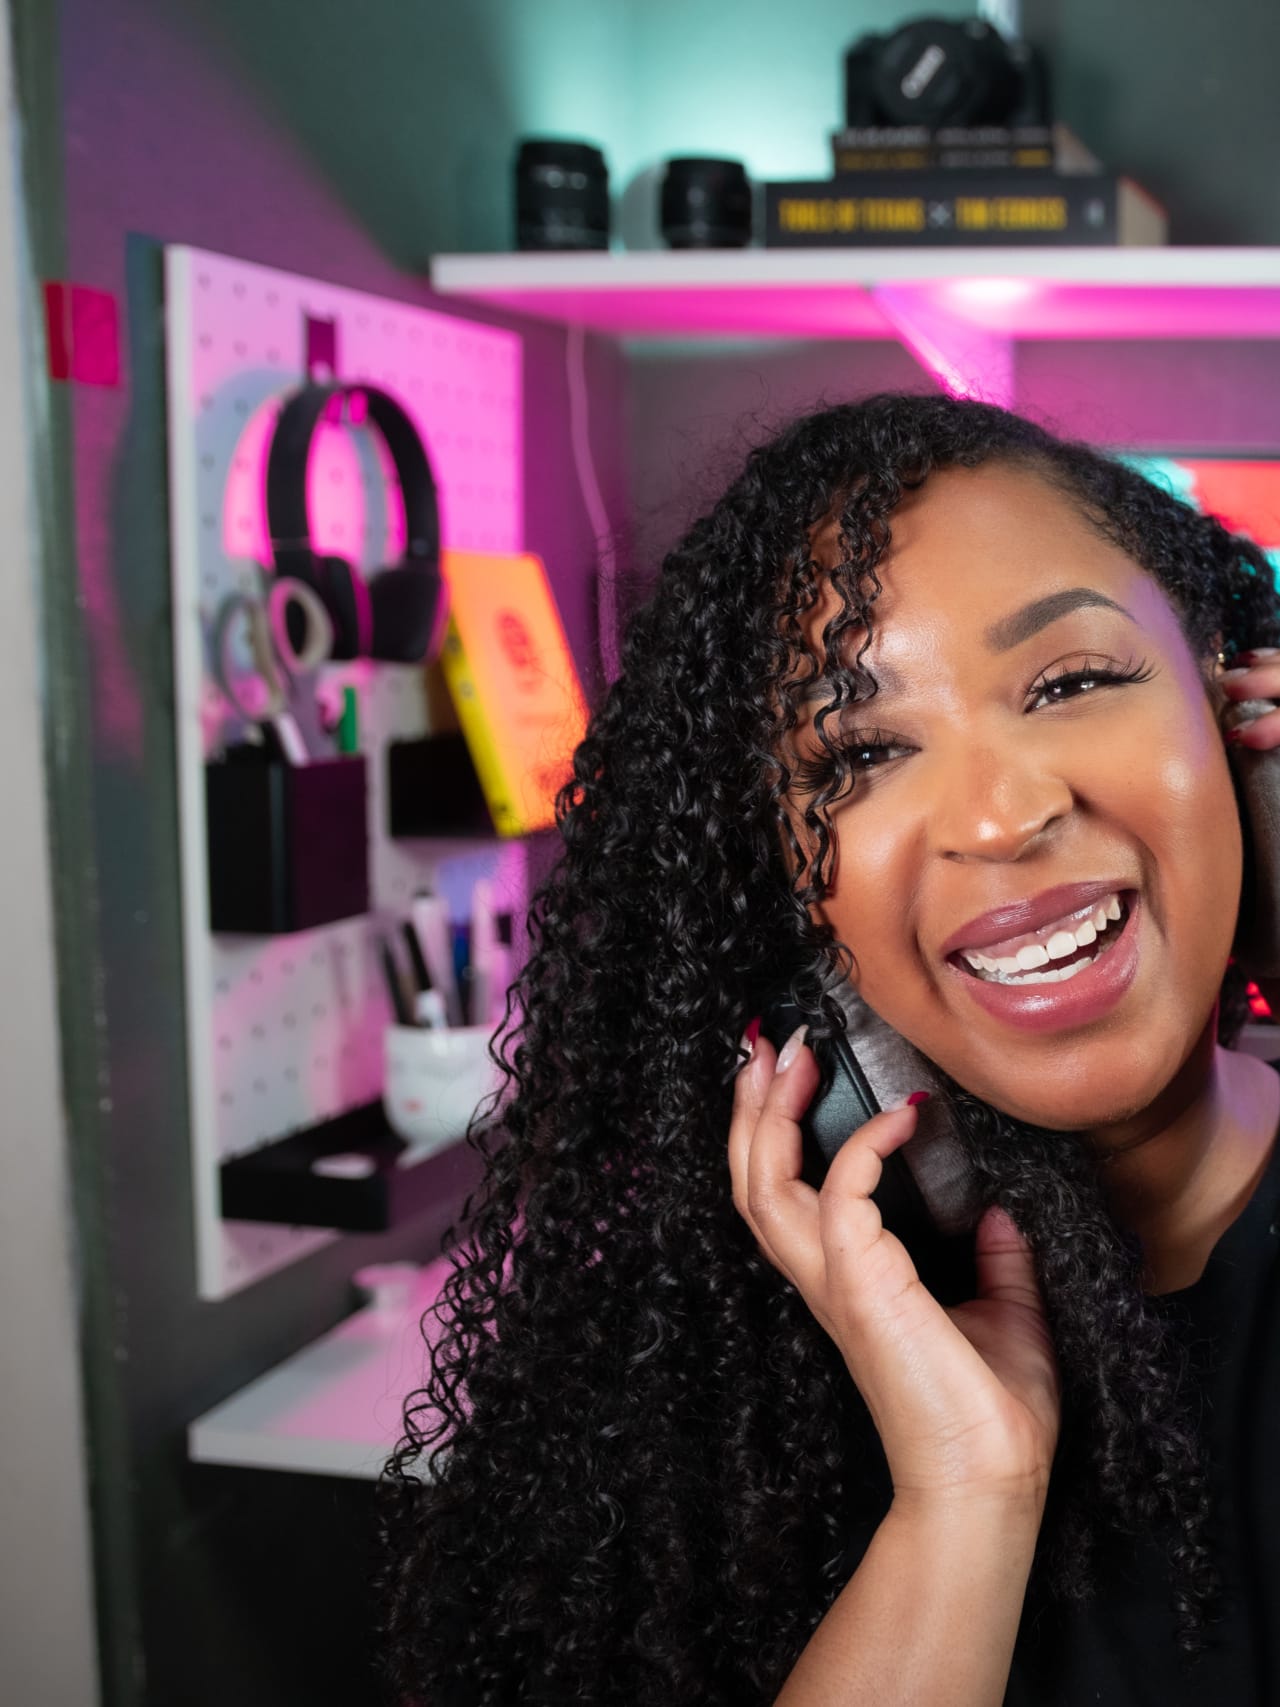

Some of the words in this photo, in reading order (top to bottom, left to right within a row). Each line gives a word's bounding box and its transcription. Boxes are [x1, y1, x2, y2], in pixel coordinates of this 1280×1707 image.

[779, 198, 834, 231] TOOLS
[837, 198, 856, 231] OF
[861, 198, 925, 231] TITANS
